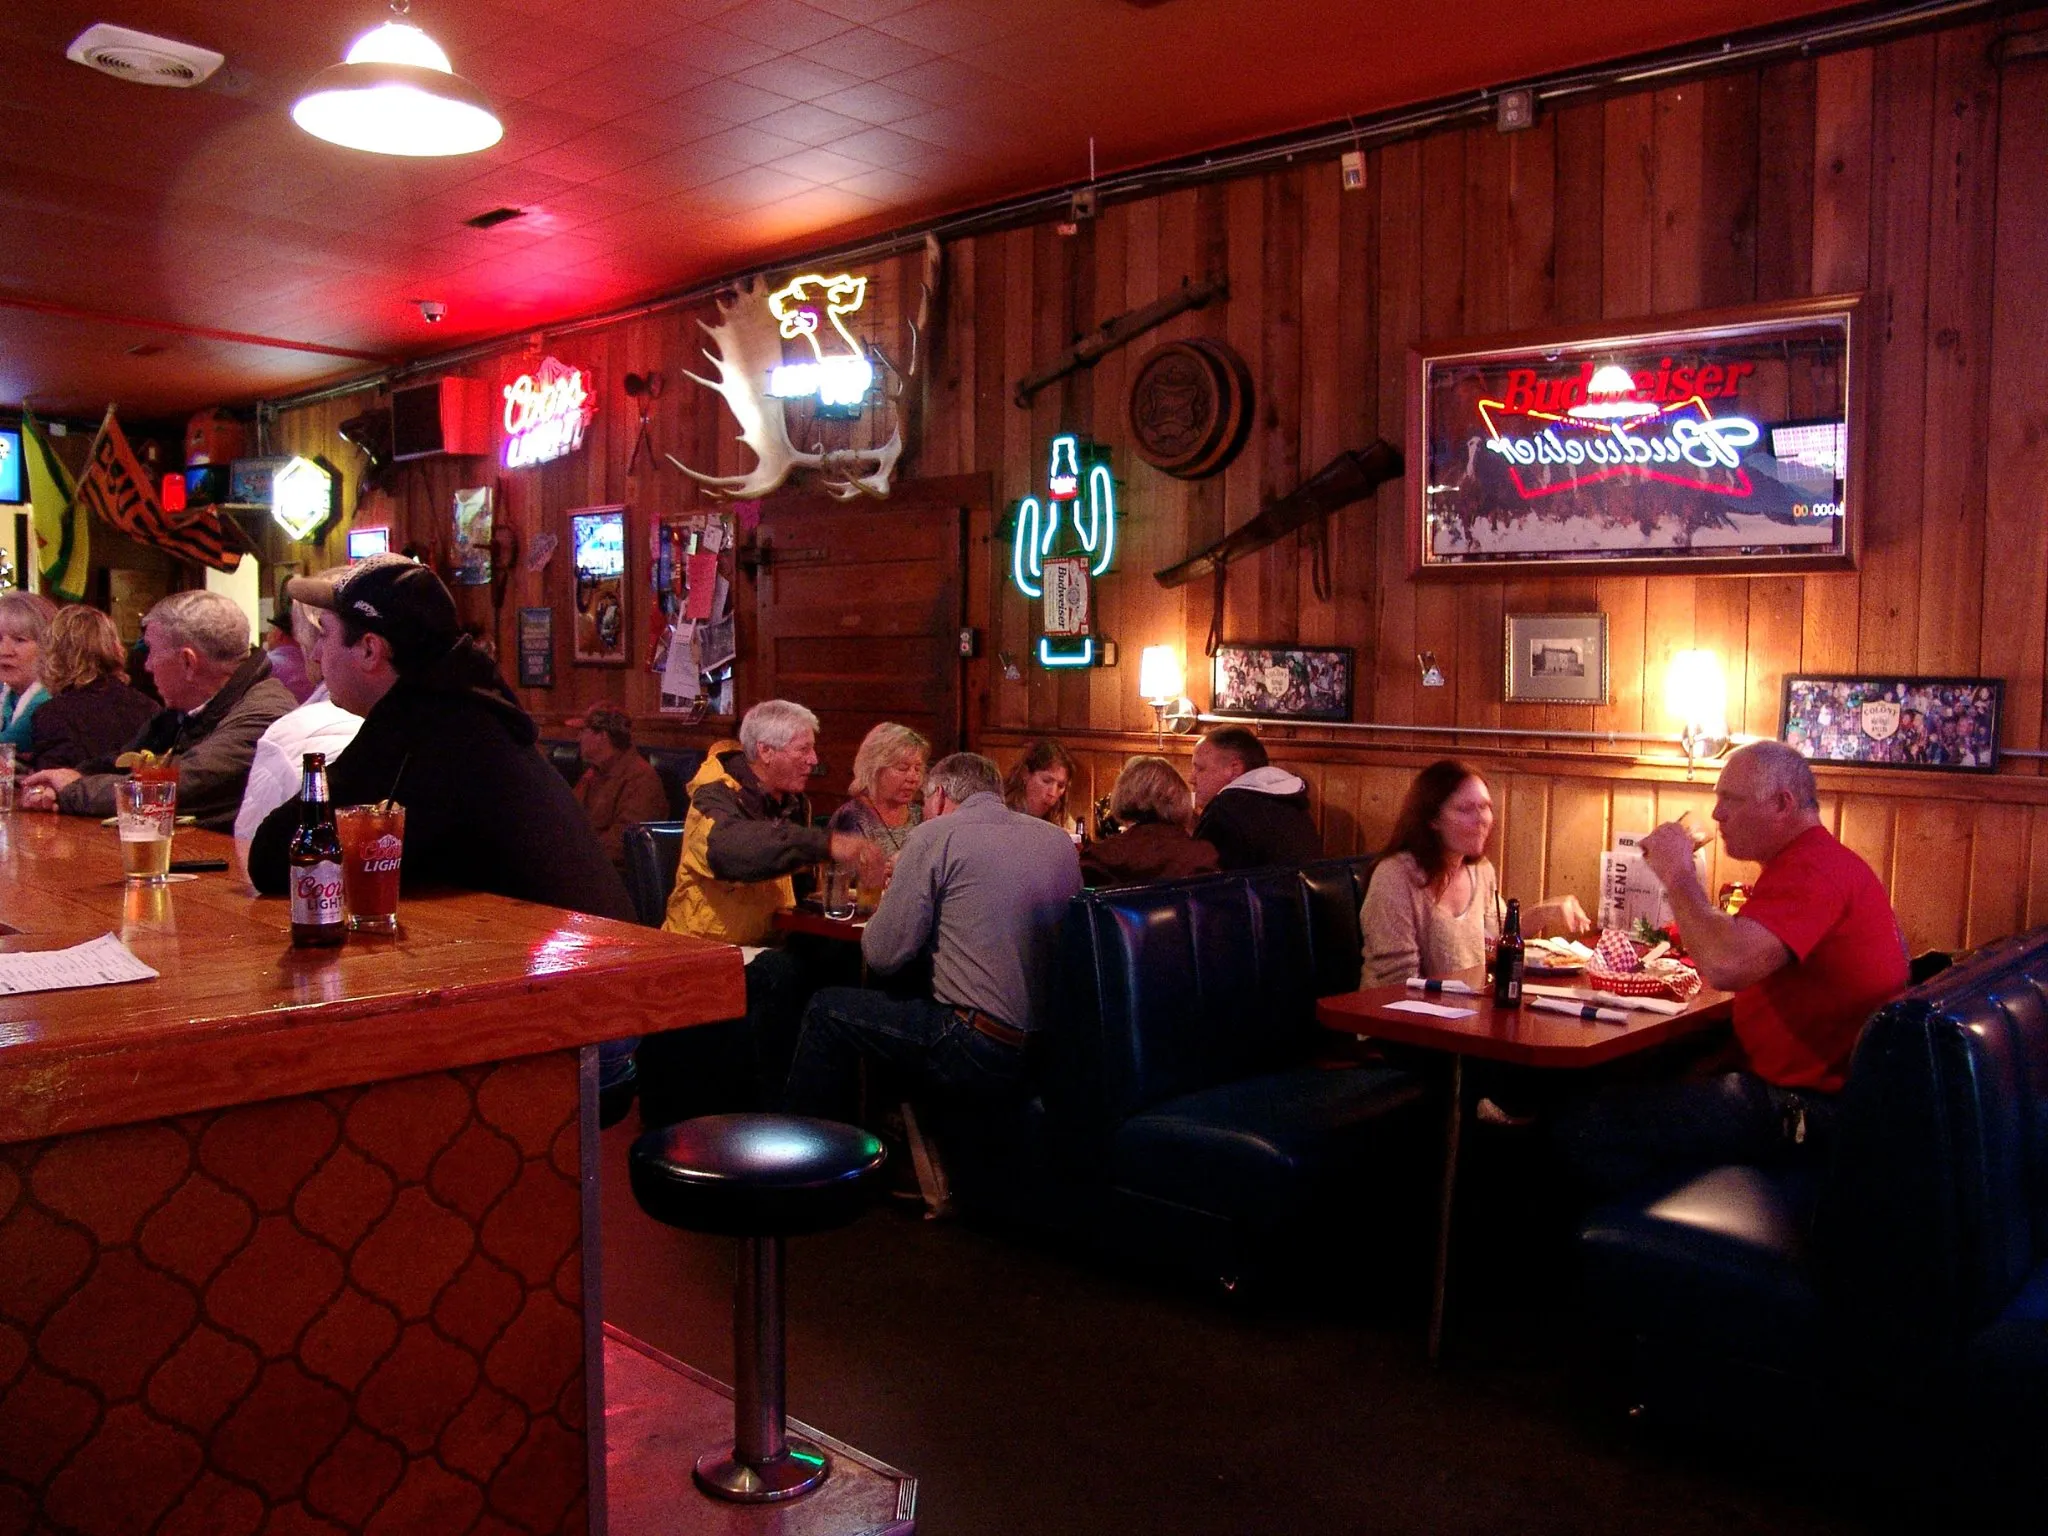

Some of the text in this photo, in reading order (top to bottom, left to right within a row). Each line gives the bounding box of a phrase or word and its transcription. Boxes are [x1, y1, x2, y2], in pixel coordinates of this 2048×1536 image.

[1057, 565, 1068, 630] Budweiser
[1618, 838, 1634, 847] BEER
[364, 857, 402, 873] LIGHT
[298, 875, 342, 899] Coor
[1614, 862, 1627, 911] MENU
